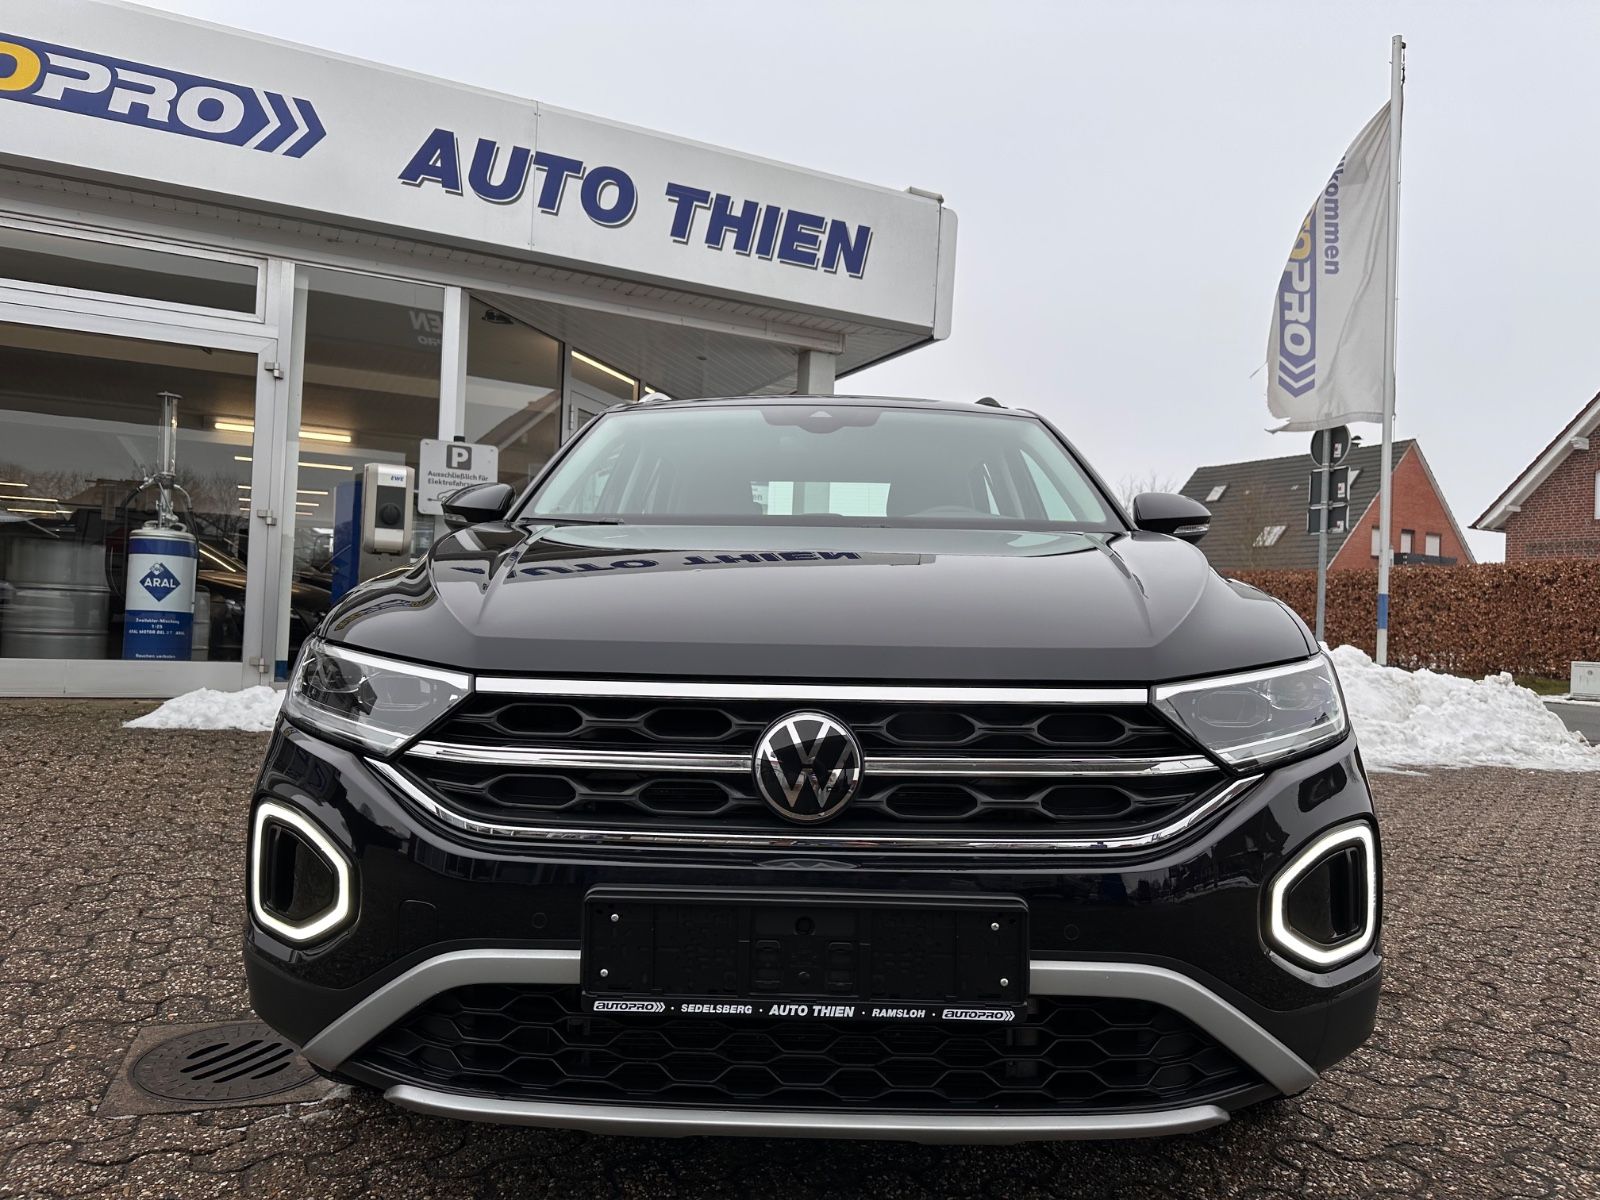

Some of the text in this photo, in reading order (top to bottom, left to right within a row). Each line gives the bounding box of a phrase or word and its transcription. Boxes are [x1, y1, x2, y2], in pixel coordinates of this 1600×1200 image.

[398, 127, 873, 280] AUTO THIEN
[451, 446, 469, 468] P
[144, 578, 176, 588] ARAL
[680, 1003, 753, 1014] SEDELSBERG
[768, 1004, 809, 1016] AUTO
[812, 1005, 855, 1018] THIEN
[871, 1008, 926, 1018] RAMSLOH
